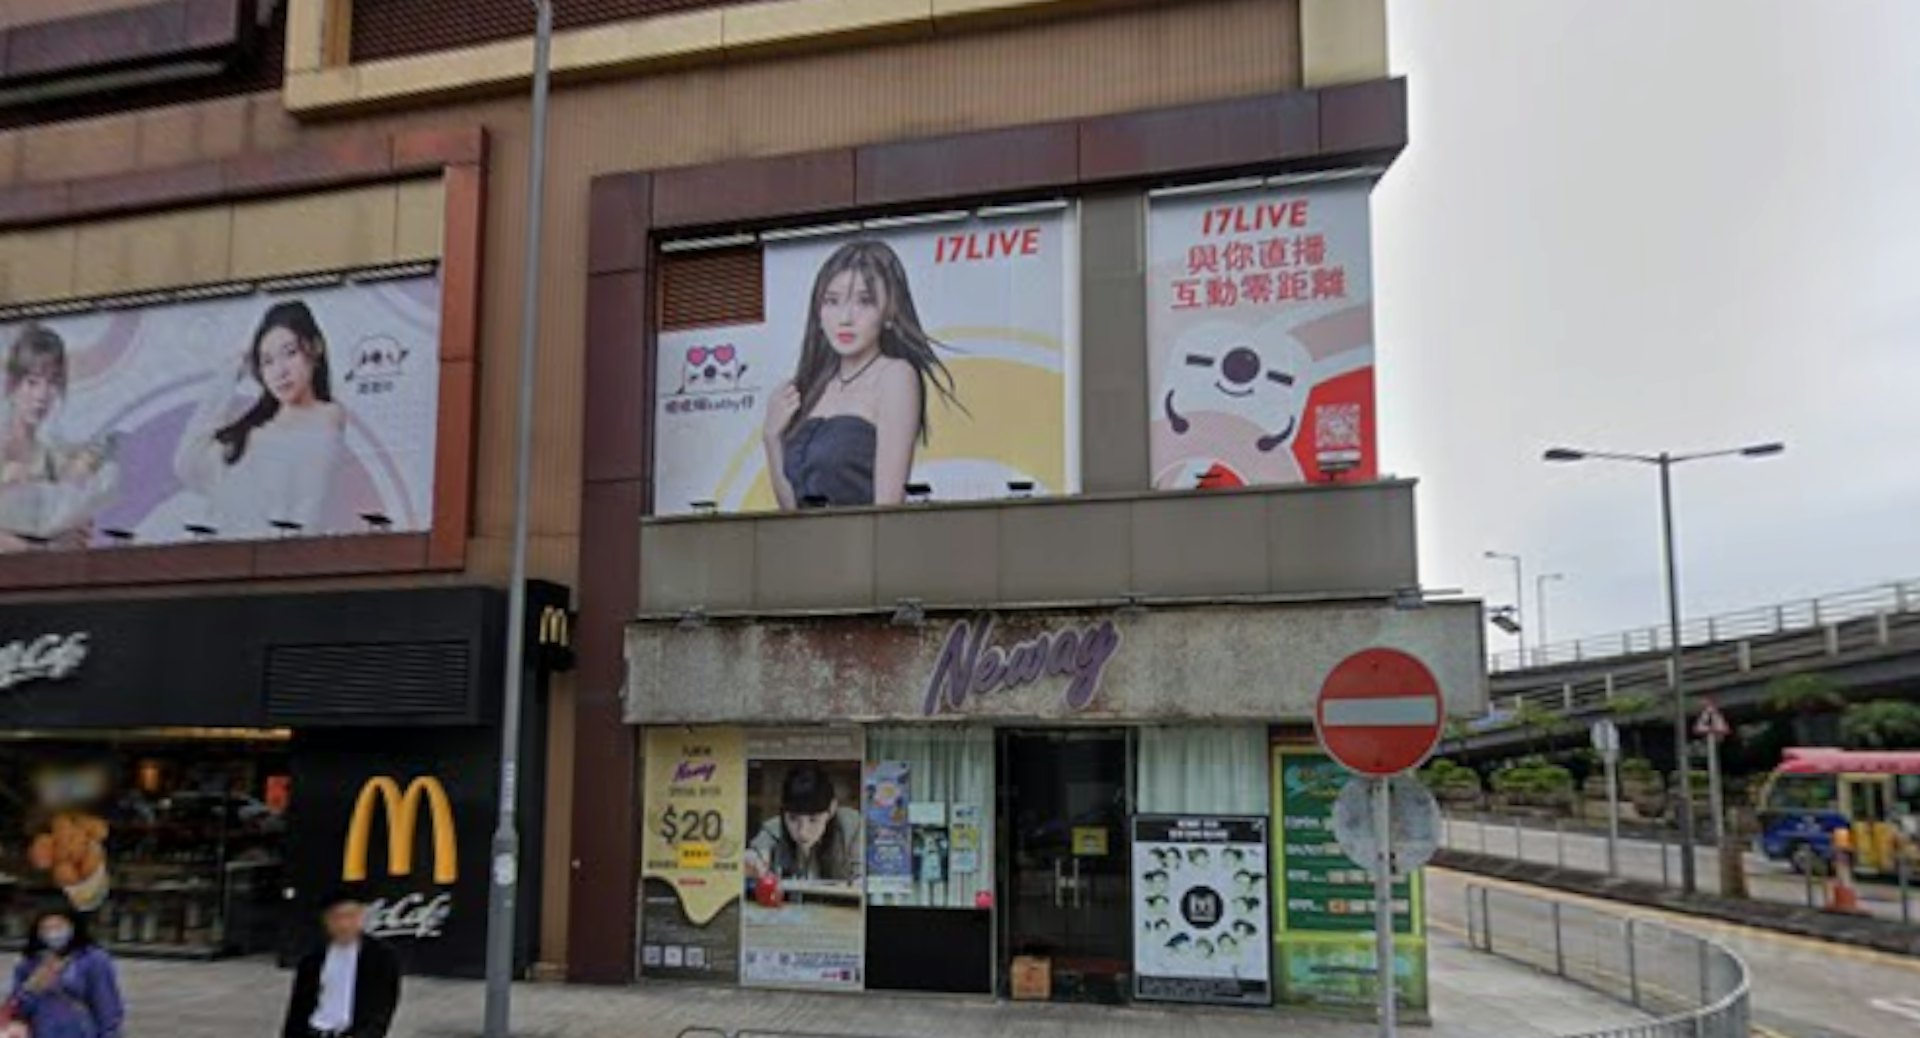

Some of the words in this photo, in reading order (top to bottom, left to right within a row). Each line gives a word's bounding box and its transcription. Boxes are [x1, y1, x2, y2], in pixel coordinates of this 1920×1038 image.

[1202, 199, 1309, 235] 17LIVE
[934, 228, 1042, 265] 17LIVE
[1187, 234, 1327, 275] 與你直播
[1170, 265, 1346, 310] 互動零距離
[924, 611, 1121, 716] Neway
[661, 803, 722, 845] $20
